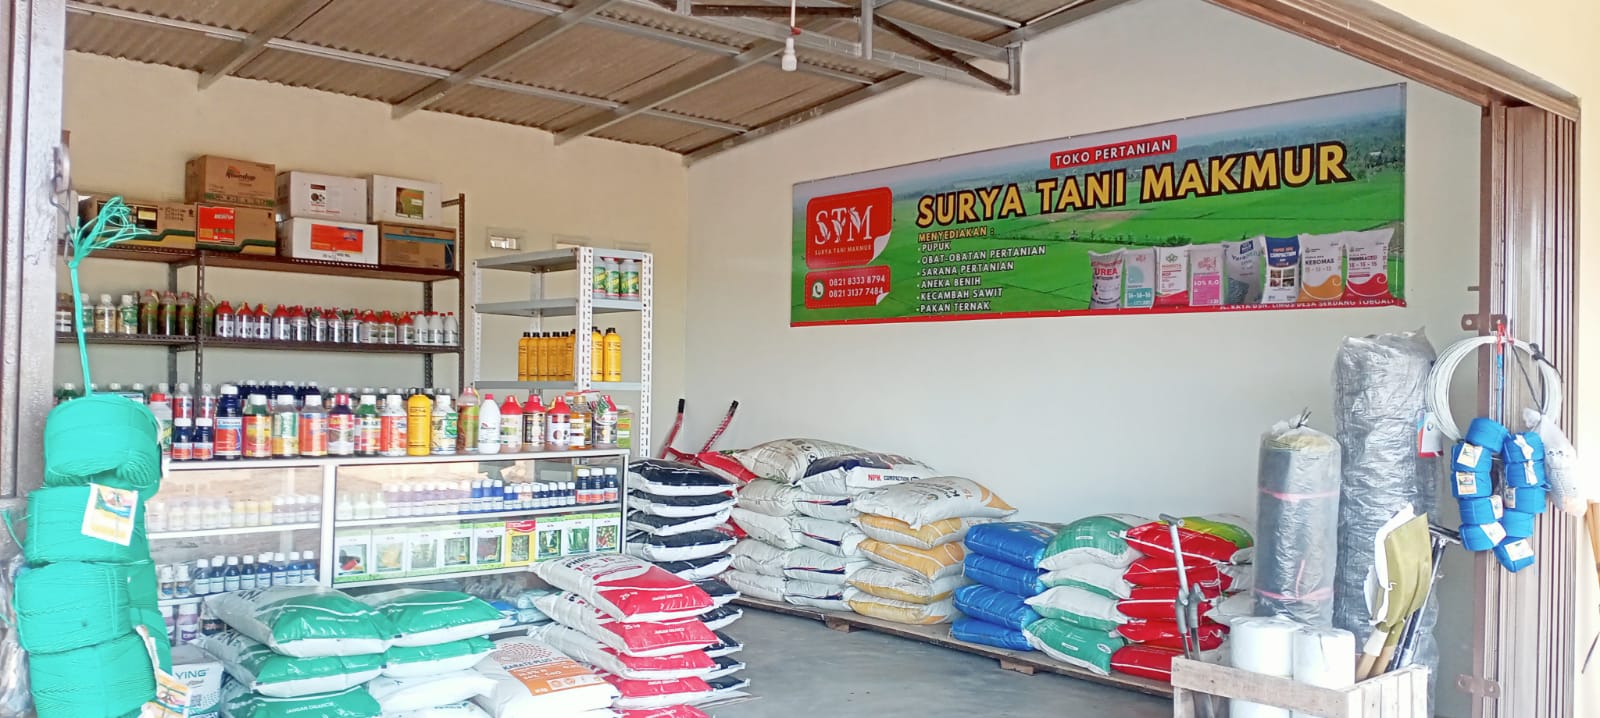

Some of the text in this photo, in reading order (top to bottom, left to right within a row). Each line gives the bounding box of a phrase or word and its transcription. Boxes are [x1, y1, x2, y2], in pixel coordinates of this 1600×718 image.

[1055, 139, 1171, 167] TOKO PERTANIAN
[916, 141, 1355, 228] SURYA TANI MAKMUR
[814, 205, 873, 246] STM
[918, 226, 987, 243] MENYEDIAKAN
[847, 244, 872, 252] MAKMUR
[922, 242, 950, 252] PUPUK
[921, 246, 1046, 265] OBAT-OBATAN PERTANIAN
[921, 261, 1014, 277] SARANA PERTANIAN
[1094, 267, 1118, 276] UREA
[828, 274, 885, 287] 0821 8333 8794
[921, 276, 981, 289] ANEKA BENIH
[828, 286, 884, 298] 0821 3137 7484
[921, 287, 1003, 301] KECAMBAH SAWIT
[920, 301, 990, 313] PAKAN TERNAK
